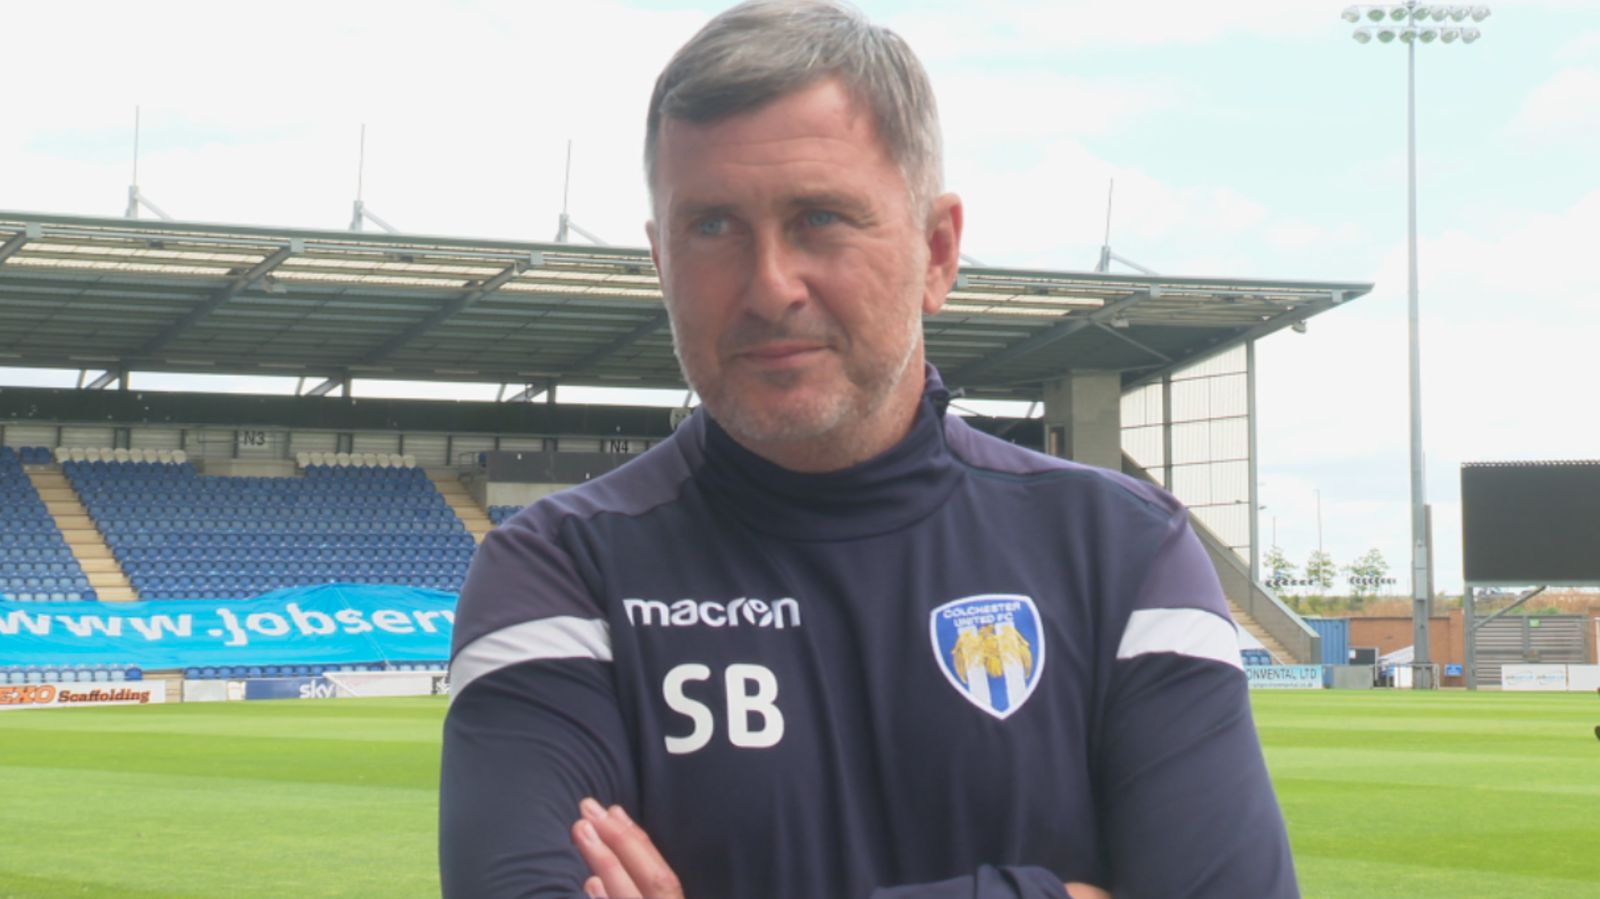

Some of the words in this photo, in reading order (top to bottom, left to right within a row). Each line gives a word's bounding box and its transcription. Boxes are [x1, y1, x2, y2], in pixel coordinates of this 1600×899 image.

[243, 431, 266, 446] N3
[610, 440, 629, 453] N4
[623, 597, 801, 629] macron
[1300, 668, 1317, 679] LTD
[58, 688, 150, 703] Scaffolding
[662, 663, 785, 755] SB
